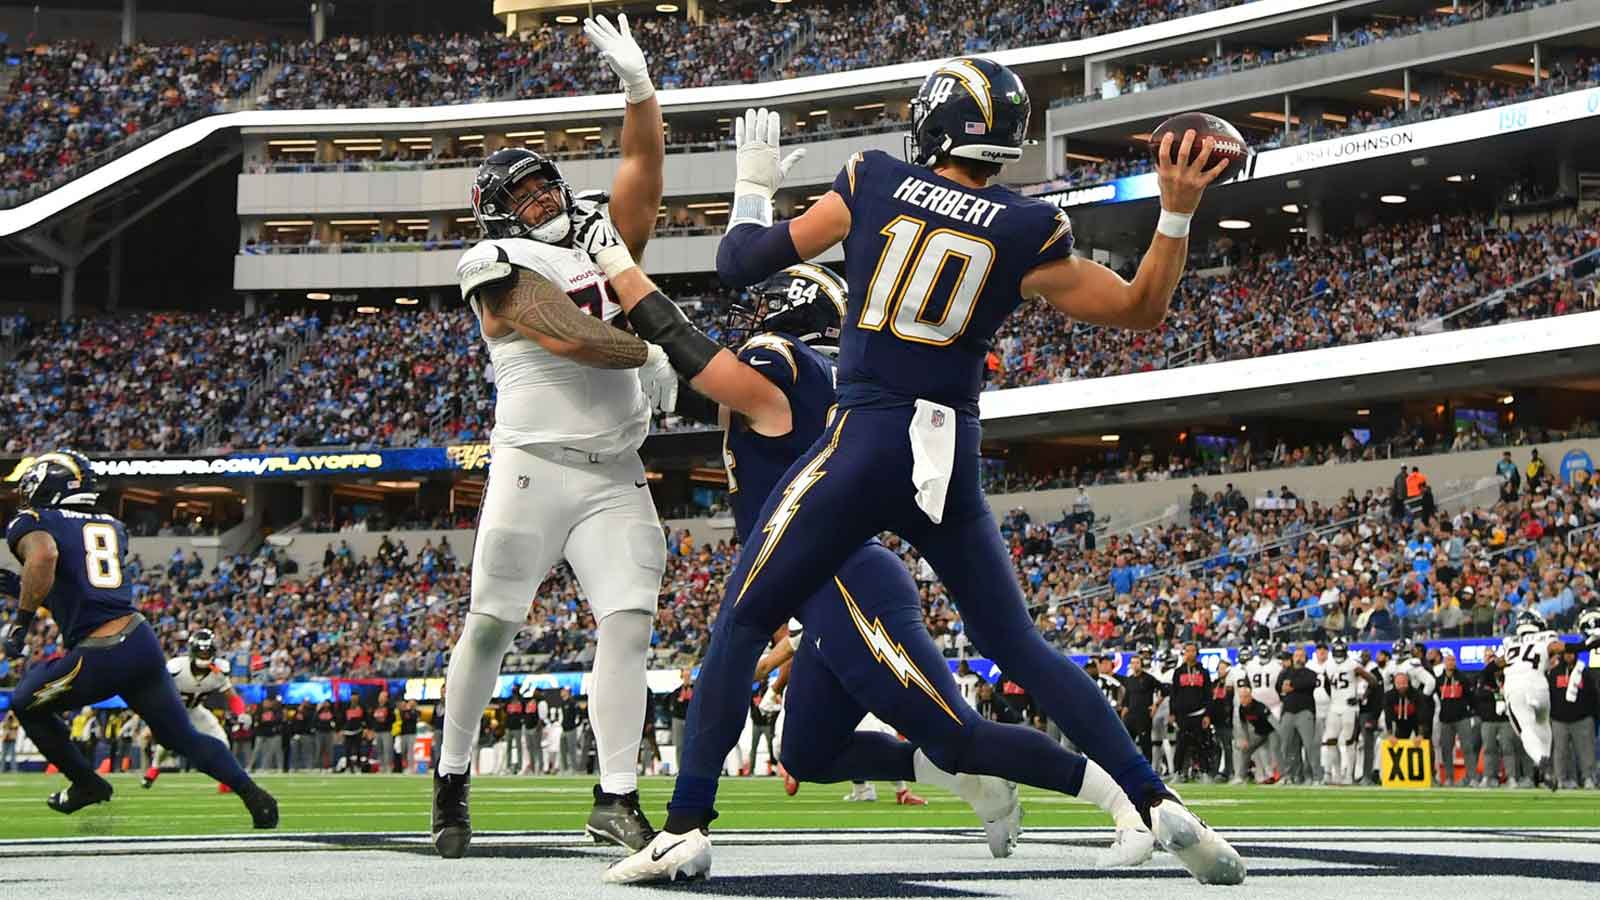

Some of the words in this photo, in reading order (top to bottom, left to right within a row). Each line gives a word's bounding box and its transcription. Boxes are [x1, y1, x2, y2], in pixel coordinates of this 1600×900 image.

[1334, 130, 1414, 158] JOHNSON
[892, 176, 1008, 229] HERBERT
[568, 269, 607, 284] HOUS
[857, 214, 997, 347] 10
[787, 278, 819, 304] 64
[90, 454, 383, 475] HARGERS.COM/PLAYOFFS
[83, 522, 122, 589] 8
[1506, 643, 1541, 670] 24
[1252, 672, 1271, 688] 91
[1330, 671, 1349, 689] 45
